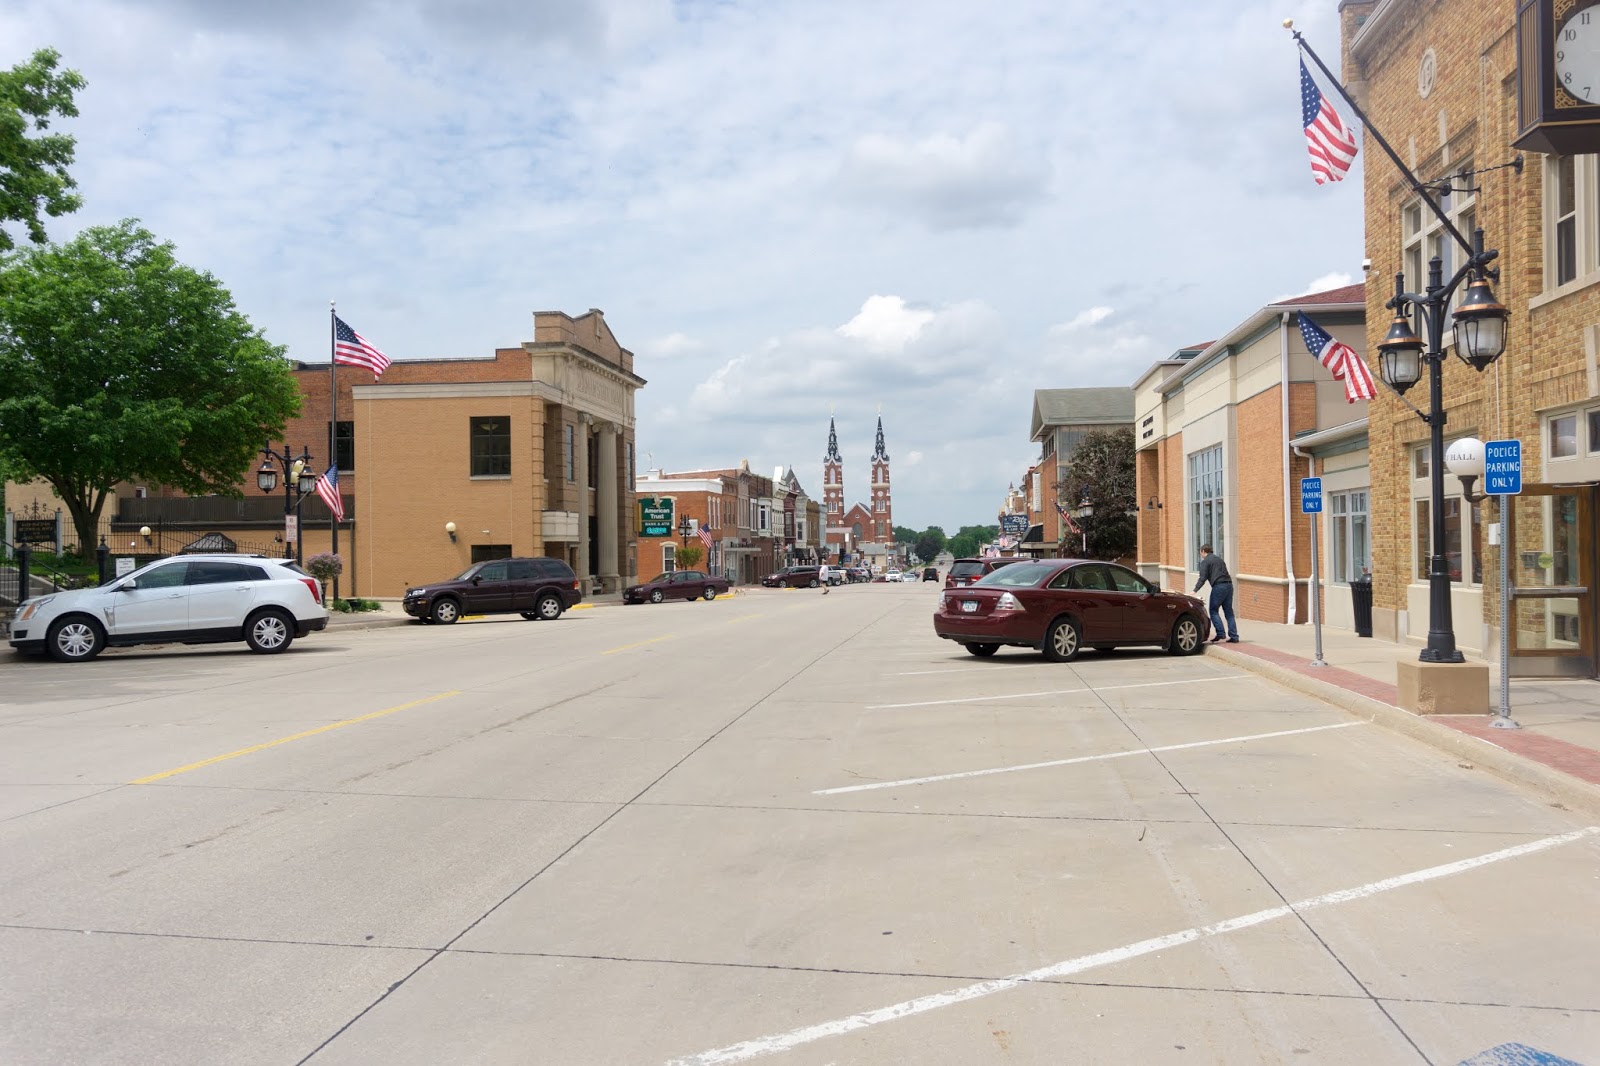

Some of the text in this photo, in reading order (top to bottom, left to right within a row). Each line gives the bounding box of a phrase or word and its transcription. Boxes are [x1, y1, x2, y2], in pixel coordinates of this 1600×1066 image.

[1581, 12, 1590, 25] 11
[1564, 29, 1576, 41] 10
[1556, 50, 1565, 63] 9
[1564, 72, 1572, 84] 8
[1583, 86, 1591, 99] 7
[1450, 453, 1476, 461] HALL
[1488, 446, 1518, 458] POLICE
[1486, 461, 1520, 473] PARKING
[1303, 481, 1320, 490] POLICE
[1492, 476, 1514, 488] ONLY
[1302, 491, 1322, 500] PARKING
[1305, 501, 1319, 509] ONLY
